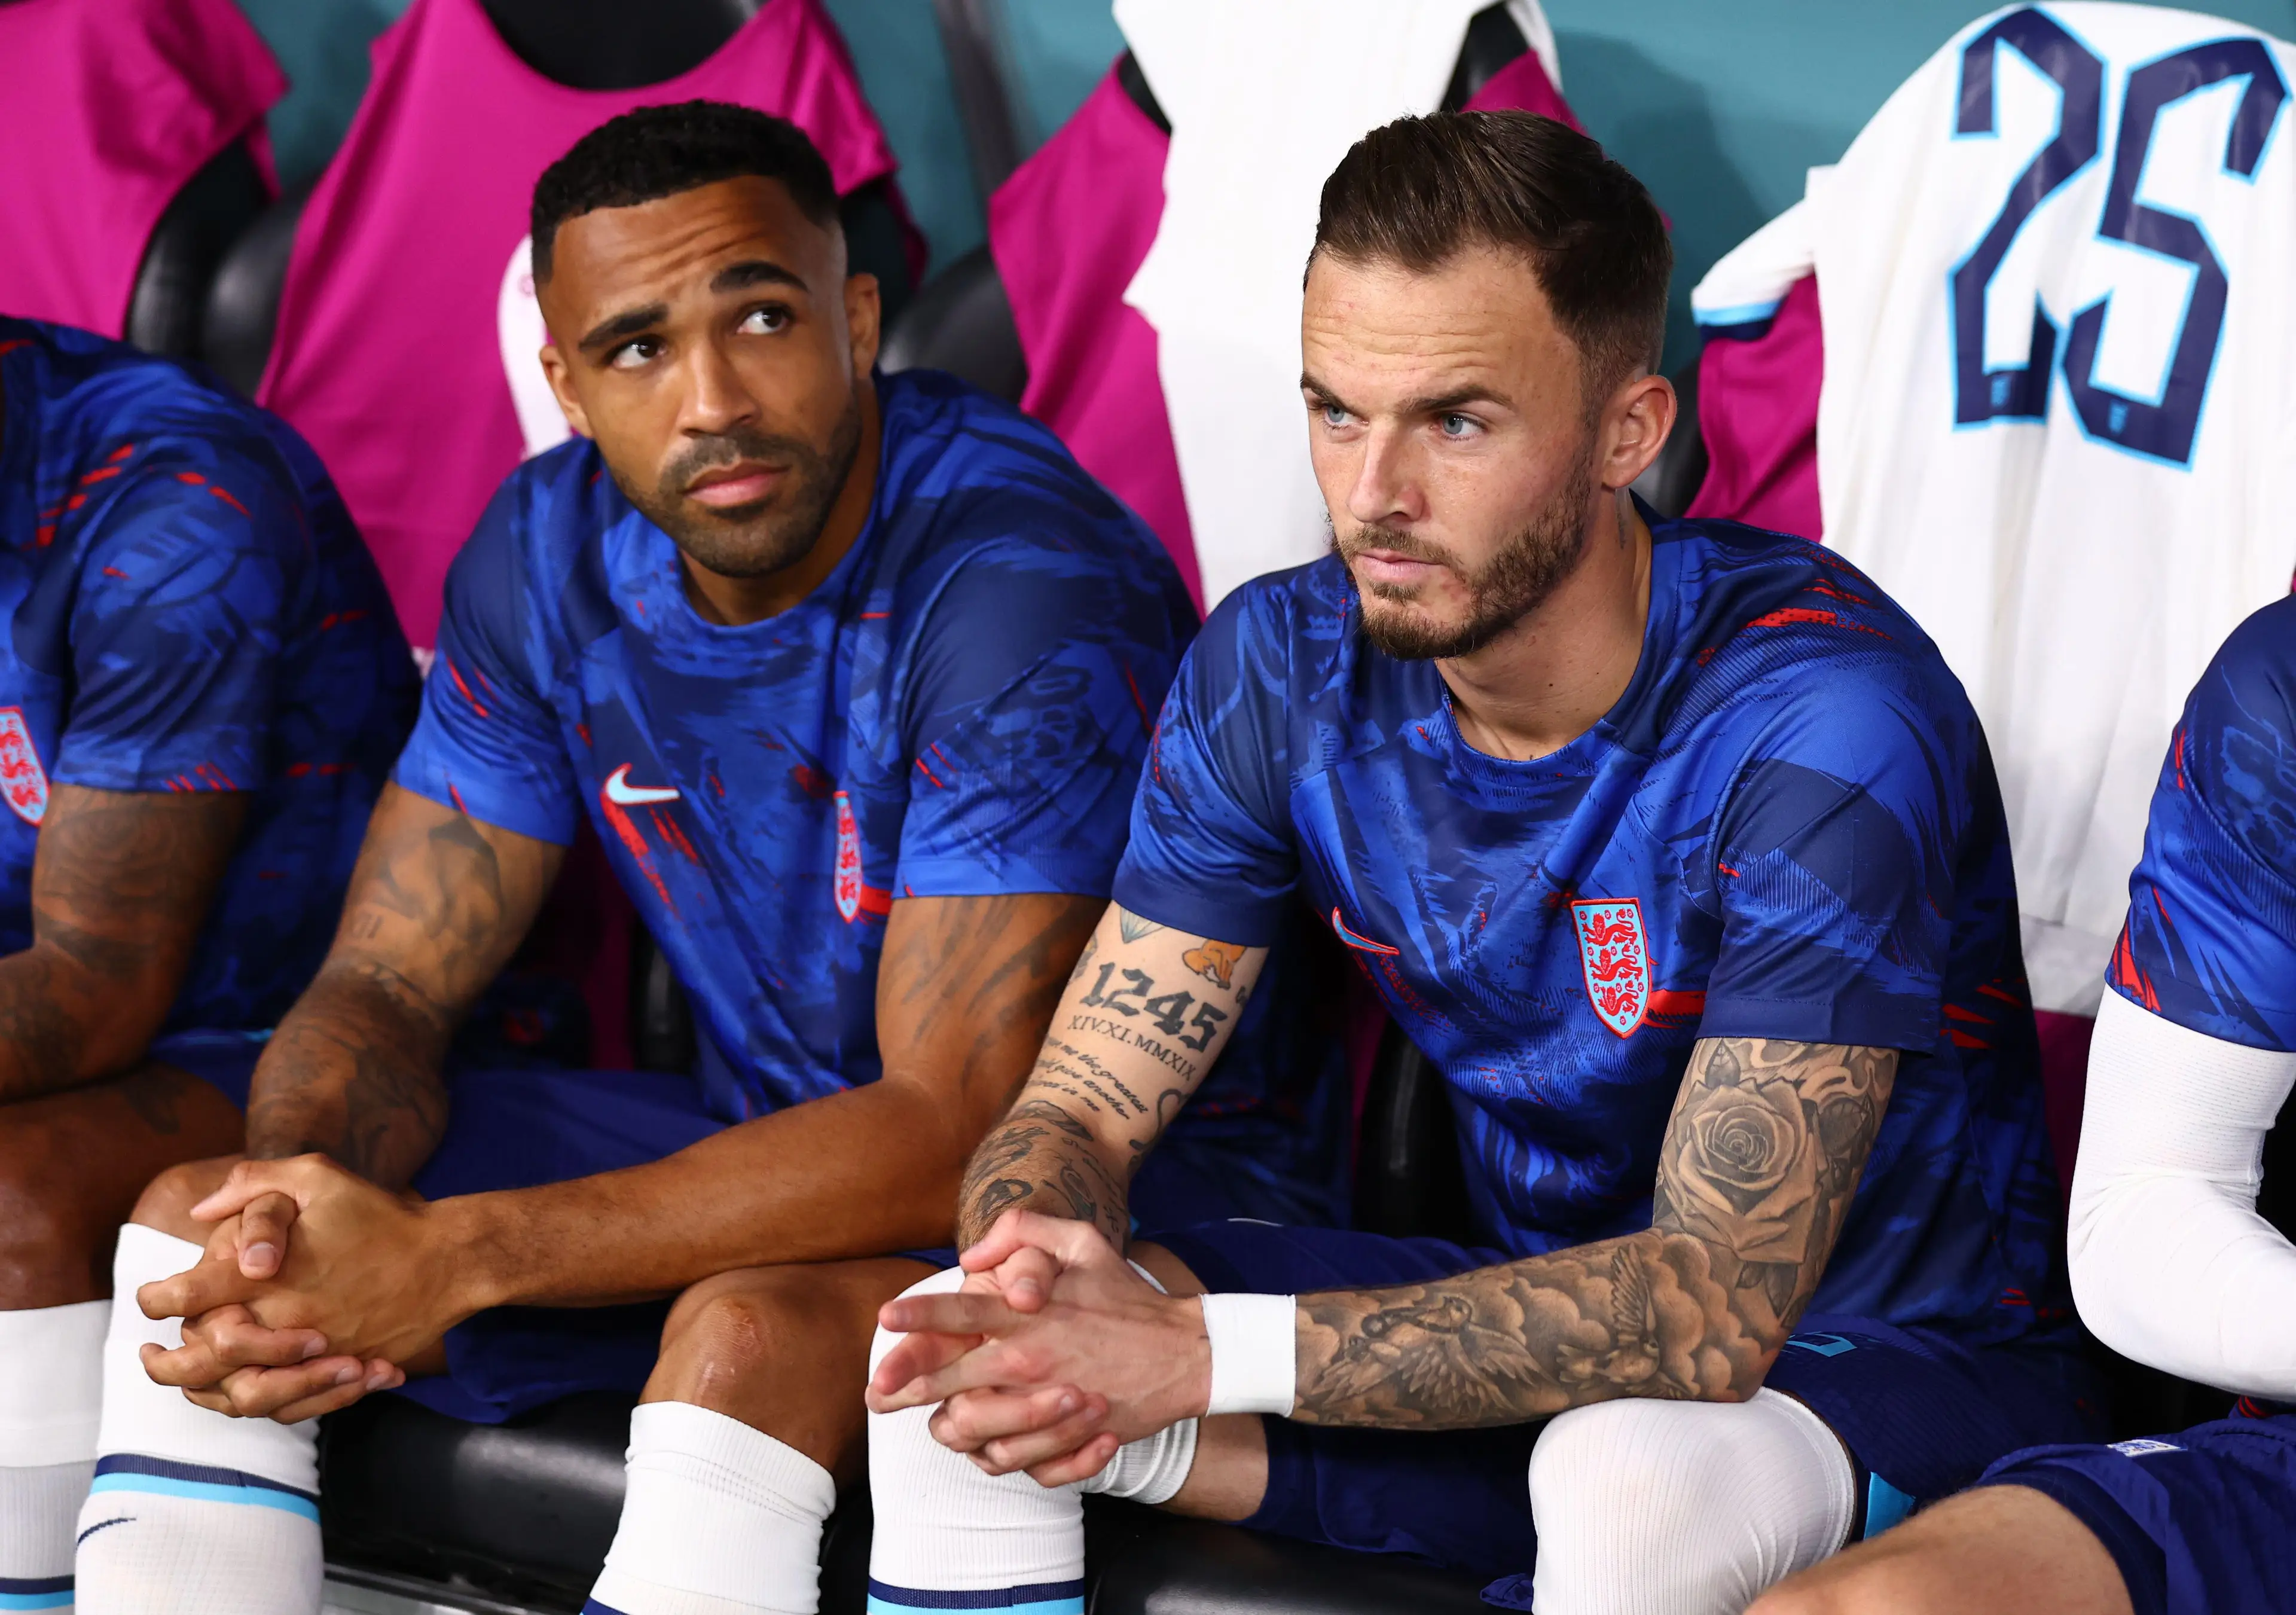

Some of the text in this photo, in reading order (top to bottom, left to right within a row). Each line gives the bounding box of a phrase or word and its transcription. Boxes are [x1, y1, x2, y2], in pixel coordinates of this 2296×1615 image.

[1946, 5, 2295, 474] 25
[1079, 961, 1228, 1053] 1245
[1077, 1054, 1101, 1069] the
[1091, 1070, 1149, 1113] greatest
[1083, 1080, 1131, 1120] another
